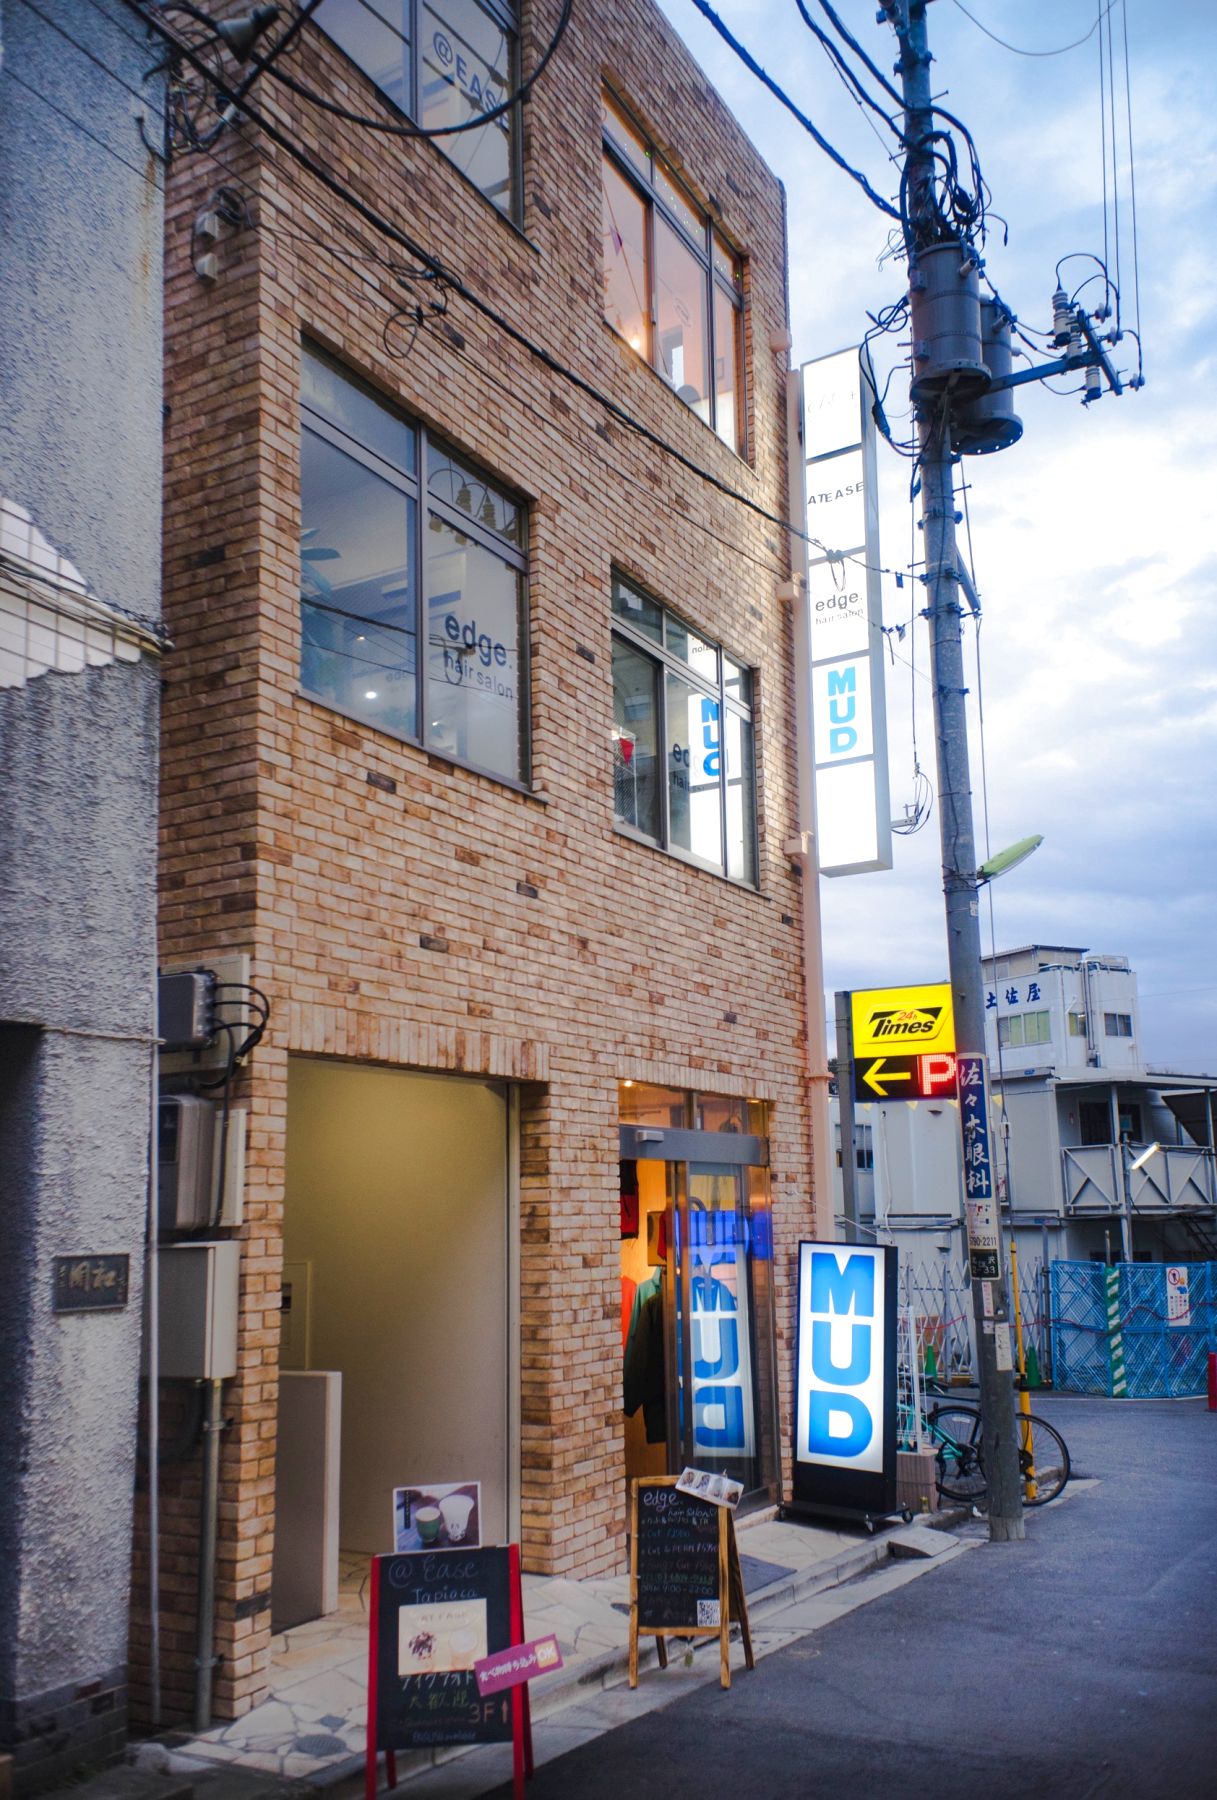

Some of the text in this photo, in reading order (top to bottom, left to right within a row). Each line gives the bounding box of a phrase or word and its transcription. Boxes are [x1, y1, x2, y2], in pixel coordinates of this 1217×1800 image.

[476, 671, 514, 701] salon
[827, 666, 858, 755] MUD
[985, 982, 1042, 1010] 土佐屋
[870, 1015, 935, 1038] Times
[921, 1053, 956, 1096] P
[959, 1061, 990, 1196] 佐々木眼科
[810, 1252, 876, 1457] MUD
